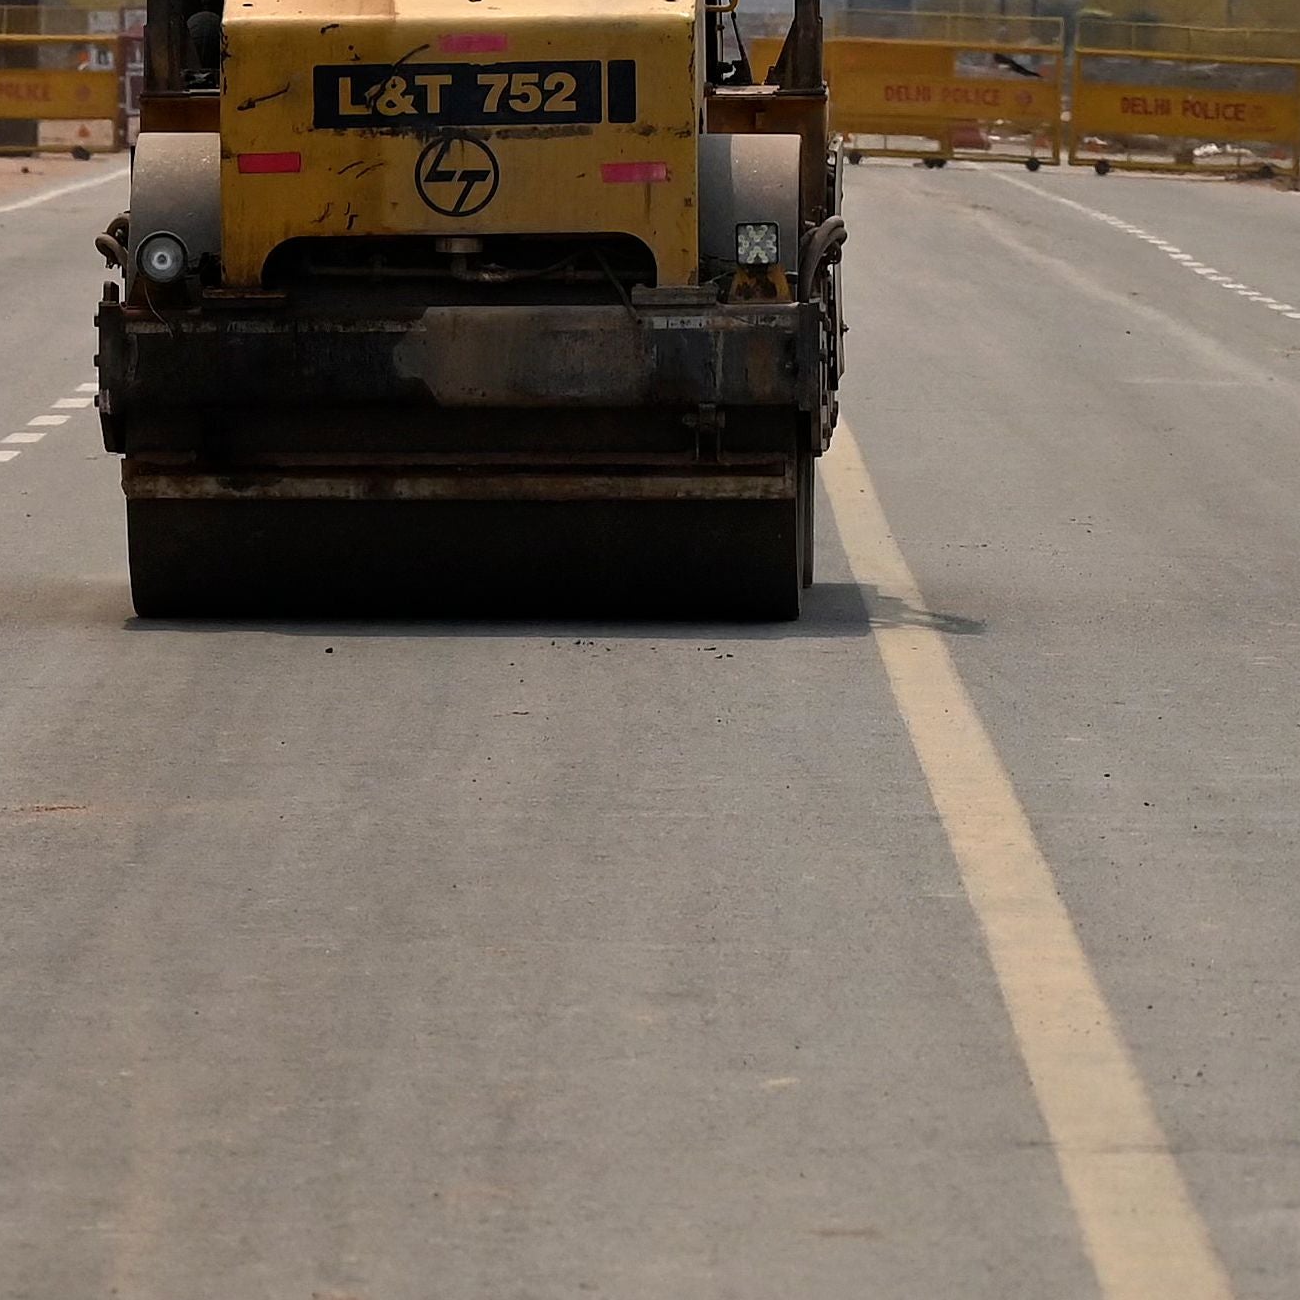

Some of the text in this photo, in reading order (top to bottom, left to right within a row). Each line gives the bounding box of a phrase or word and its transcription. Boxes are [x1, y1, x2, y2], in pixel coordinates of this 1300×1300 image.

[338, 72, 577, 116] L&T 752
[884, 85, 1001, 107] DELHI POLICE
[1121, 96, 1247, 121] DELHI POLICE
